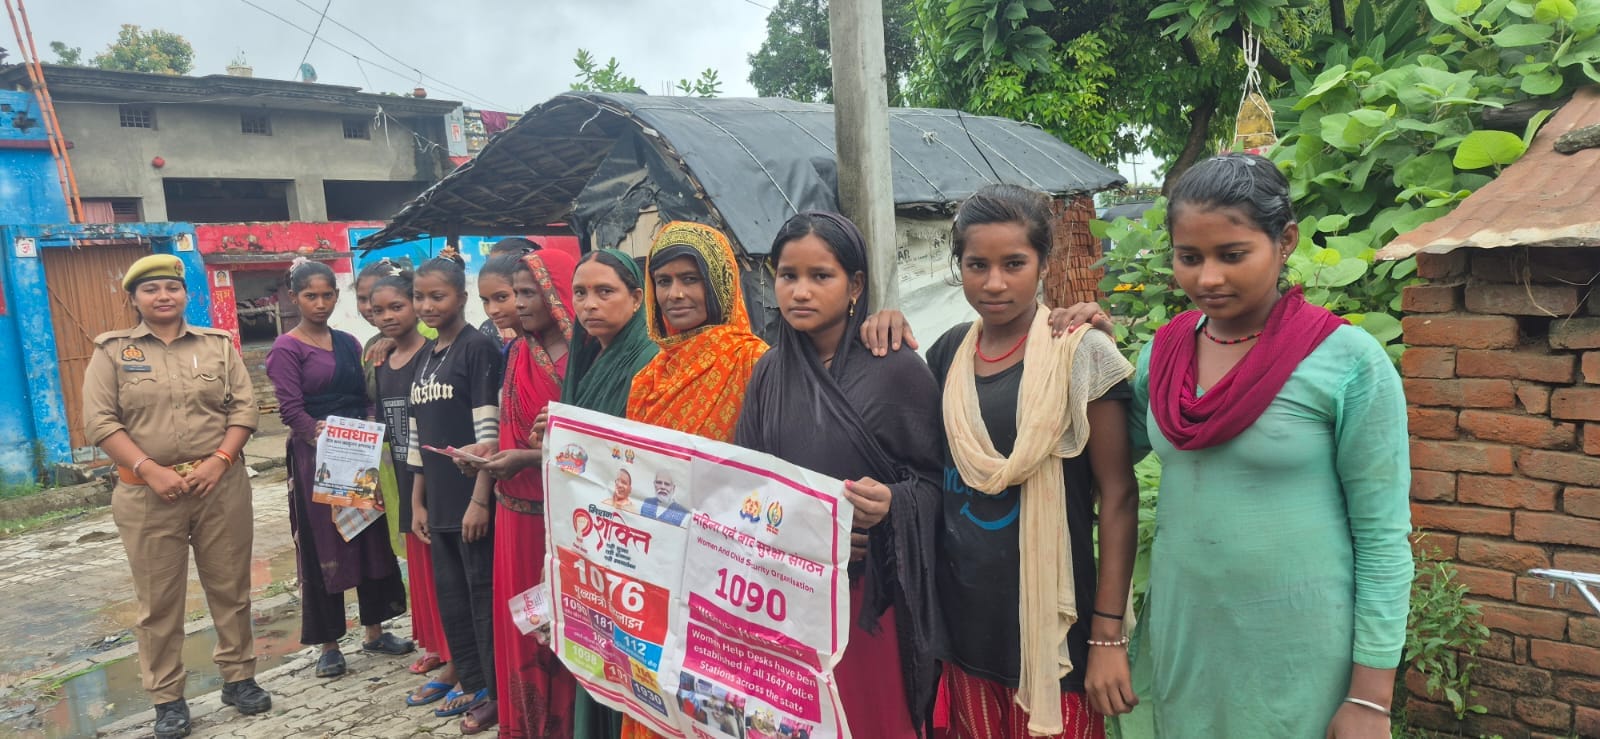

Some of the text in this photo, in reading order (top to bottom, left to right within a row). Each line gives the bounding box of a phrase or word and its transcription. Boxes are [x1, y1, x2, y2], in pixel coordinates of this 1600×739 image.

[327, 425, 379, 444] सावधान
[594, 511, 652, 555] शक्ति
[722, 525, 737, 540] एवं
[757, 541, 785, 558] सुरक्षा
[789, 552, 825, 576] संगठन
[697, 536, 717, 551] Women
[718, 547, 730, 557] And
[771, 569, 814, 593] Organisation
[573, 559, 645, 612] 1076
[715, 567, 787, 622] 1090
[594, 614, 613, 632] 181
[624, 636, 647, 656] 112
[722, 642, 744, 657] Help
[747, 651, 773, 667] Desks
[774, 661, 795, 677] have
[634, 682, 662, 704] 1930
[700, 661, 803, 713] Stations across the state
[744, 663, 751, 673] in
[753, 667, 764, 679] all
[766, 673, 786, 688] 1647
[787, 684, 814, 701] Police
